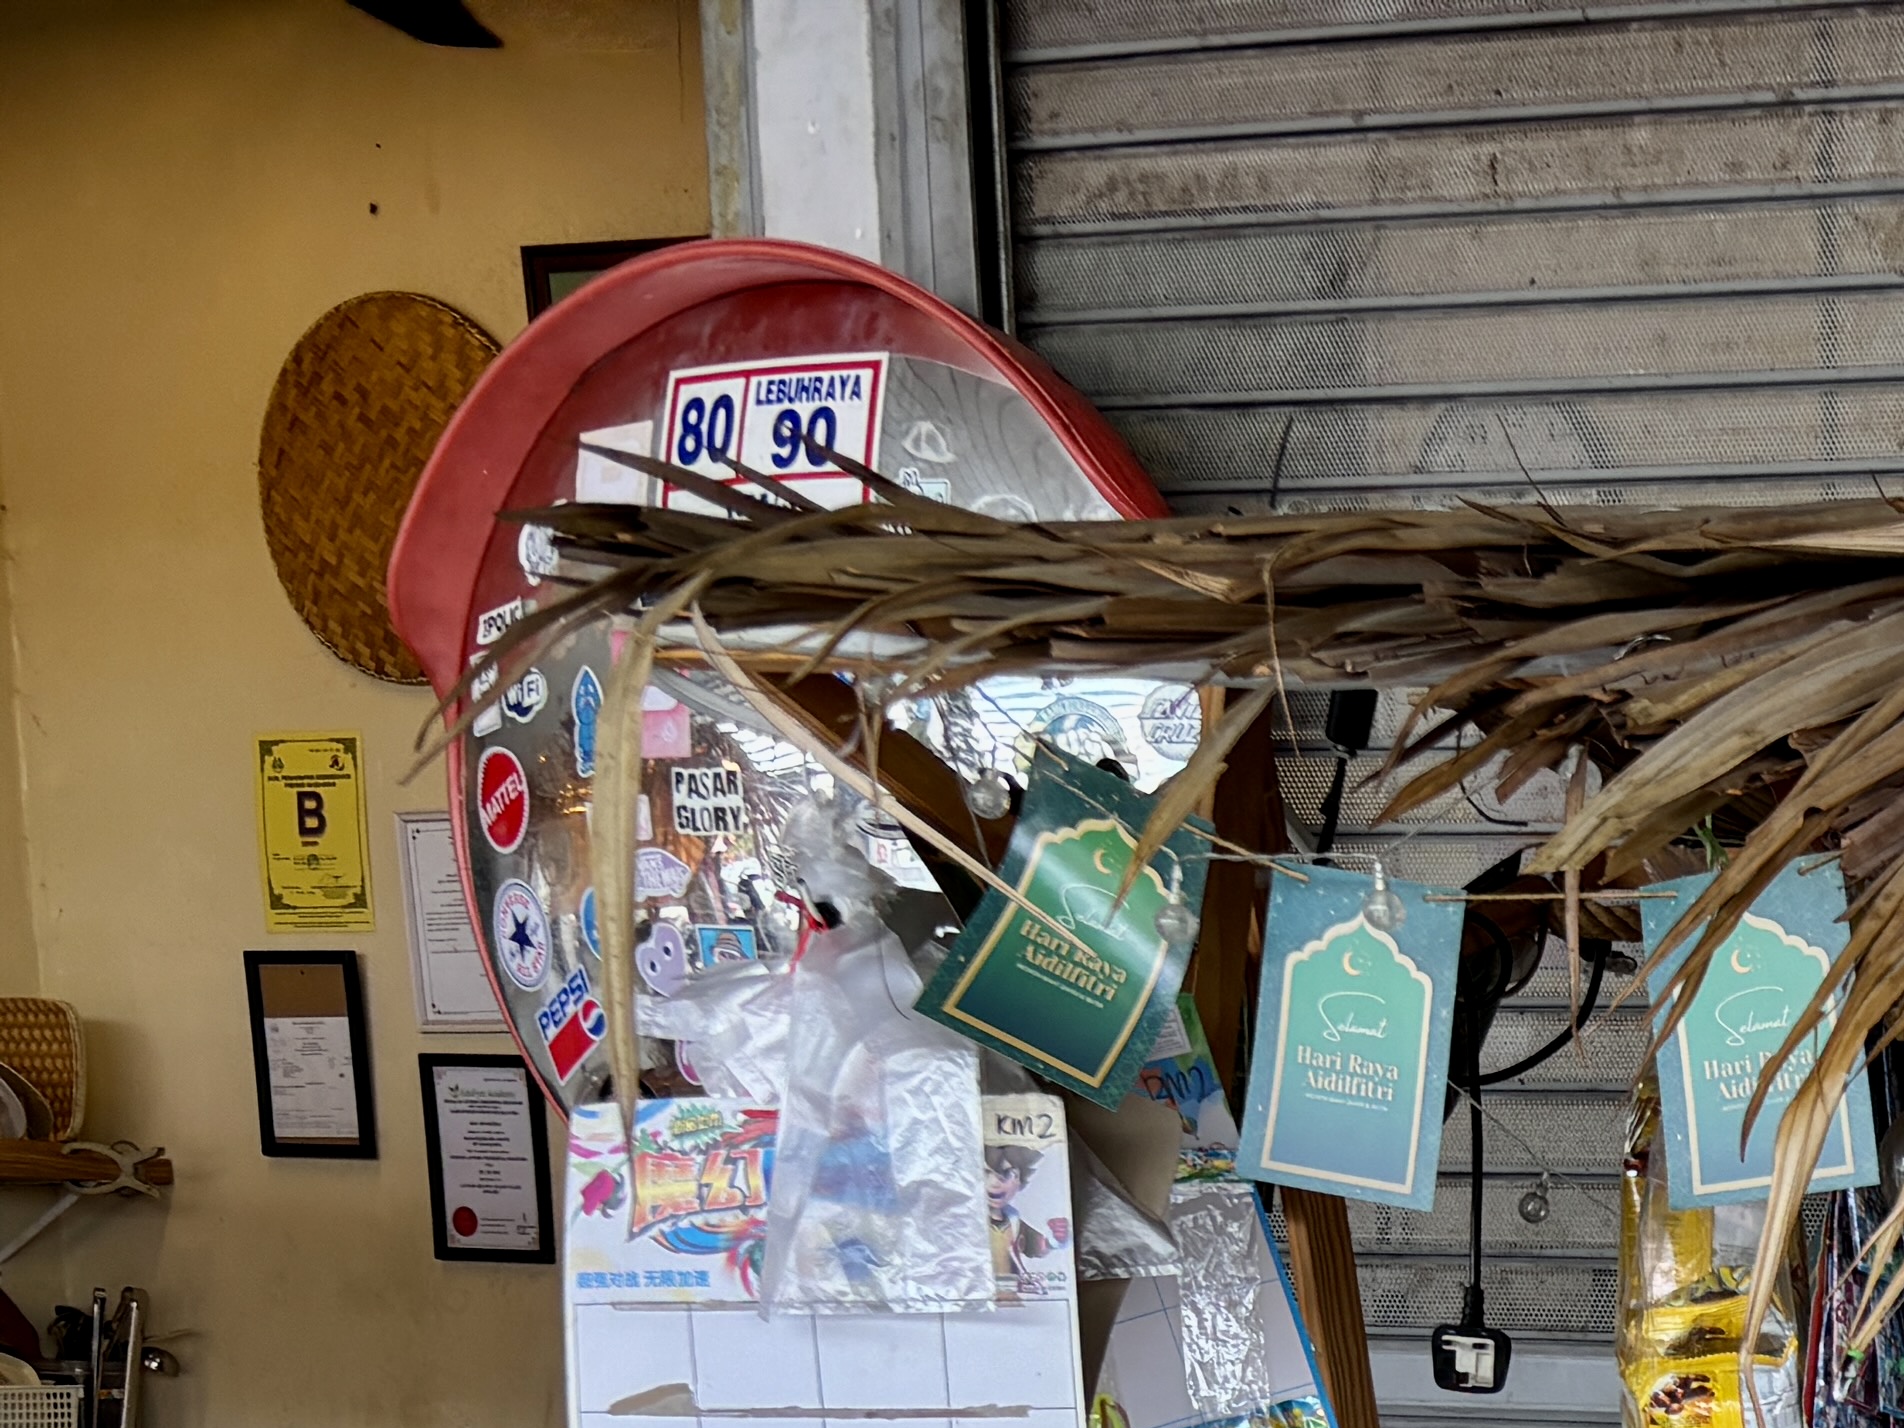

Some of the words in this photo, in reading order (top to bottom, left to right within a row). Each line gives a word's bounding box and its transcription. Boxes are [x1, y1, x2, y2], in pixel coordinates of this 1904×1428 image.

[756, 375, 862, 405] LEBUHRAYA
[677, 394, 735, 465] 80
[771, 406, 836, 468] 90
[483, 775, 526, 826] MATTEL
[675, 769, 739, 800] PASAR
[297, 790, 327, 839] B
[676, 805, 743, 832] GLORY
[1020, 919, 1071, 956] Hari
[1016, 943, 1118, 1001] Aidilfitri
[539, 968, 590, 1040] PEPSI
[1318, 991, 1388, 1042] Selamat
[1715, 985, 1790, 1046] Selamat
[1297, 1044, 1342, 1071] Hari
[1349, 1054, 1400, 1081] Raya
[1302, 1069, 1394, 1102] Aidilfitri
[1703, 1054, 1753, 1080] Hari
[1759, 1049, 1814, 1073] Rya
